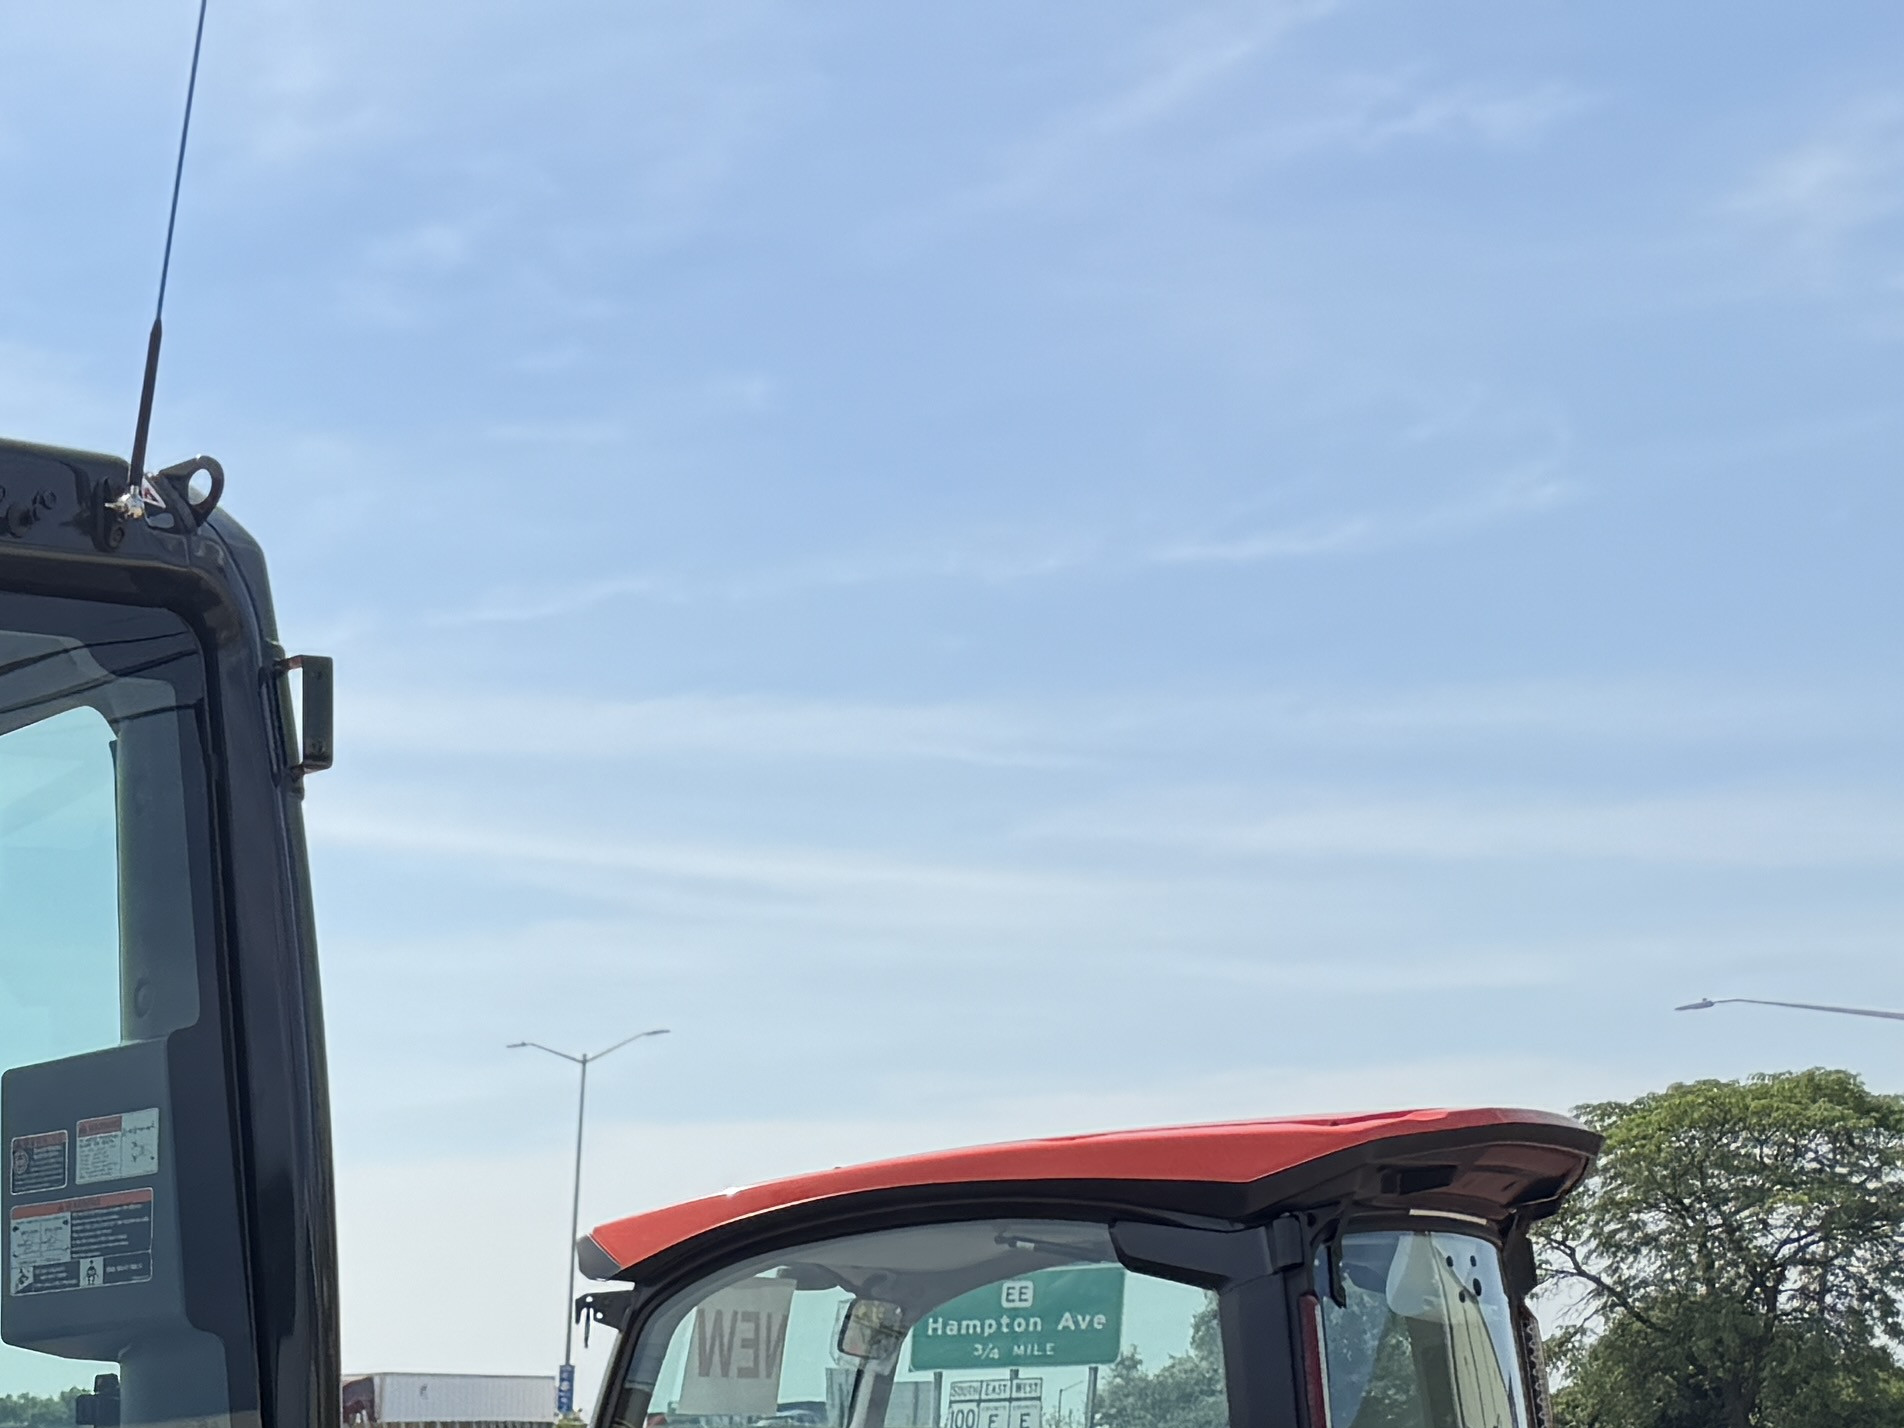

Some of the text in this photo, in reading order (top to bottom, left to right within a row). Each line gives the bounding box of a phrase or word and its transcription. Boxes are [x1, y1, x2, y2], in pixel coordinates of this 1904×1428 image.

[1005, 1286, 1030, 1303] EE
[927, 1311, 1106, 1336] Hampton Ave
[973, 1343, 1055, 1359] 3/4 MILE
[985, 1382, 1008, 1396] EAST
[1015, 1382, 1039, 1394] WEST
